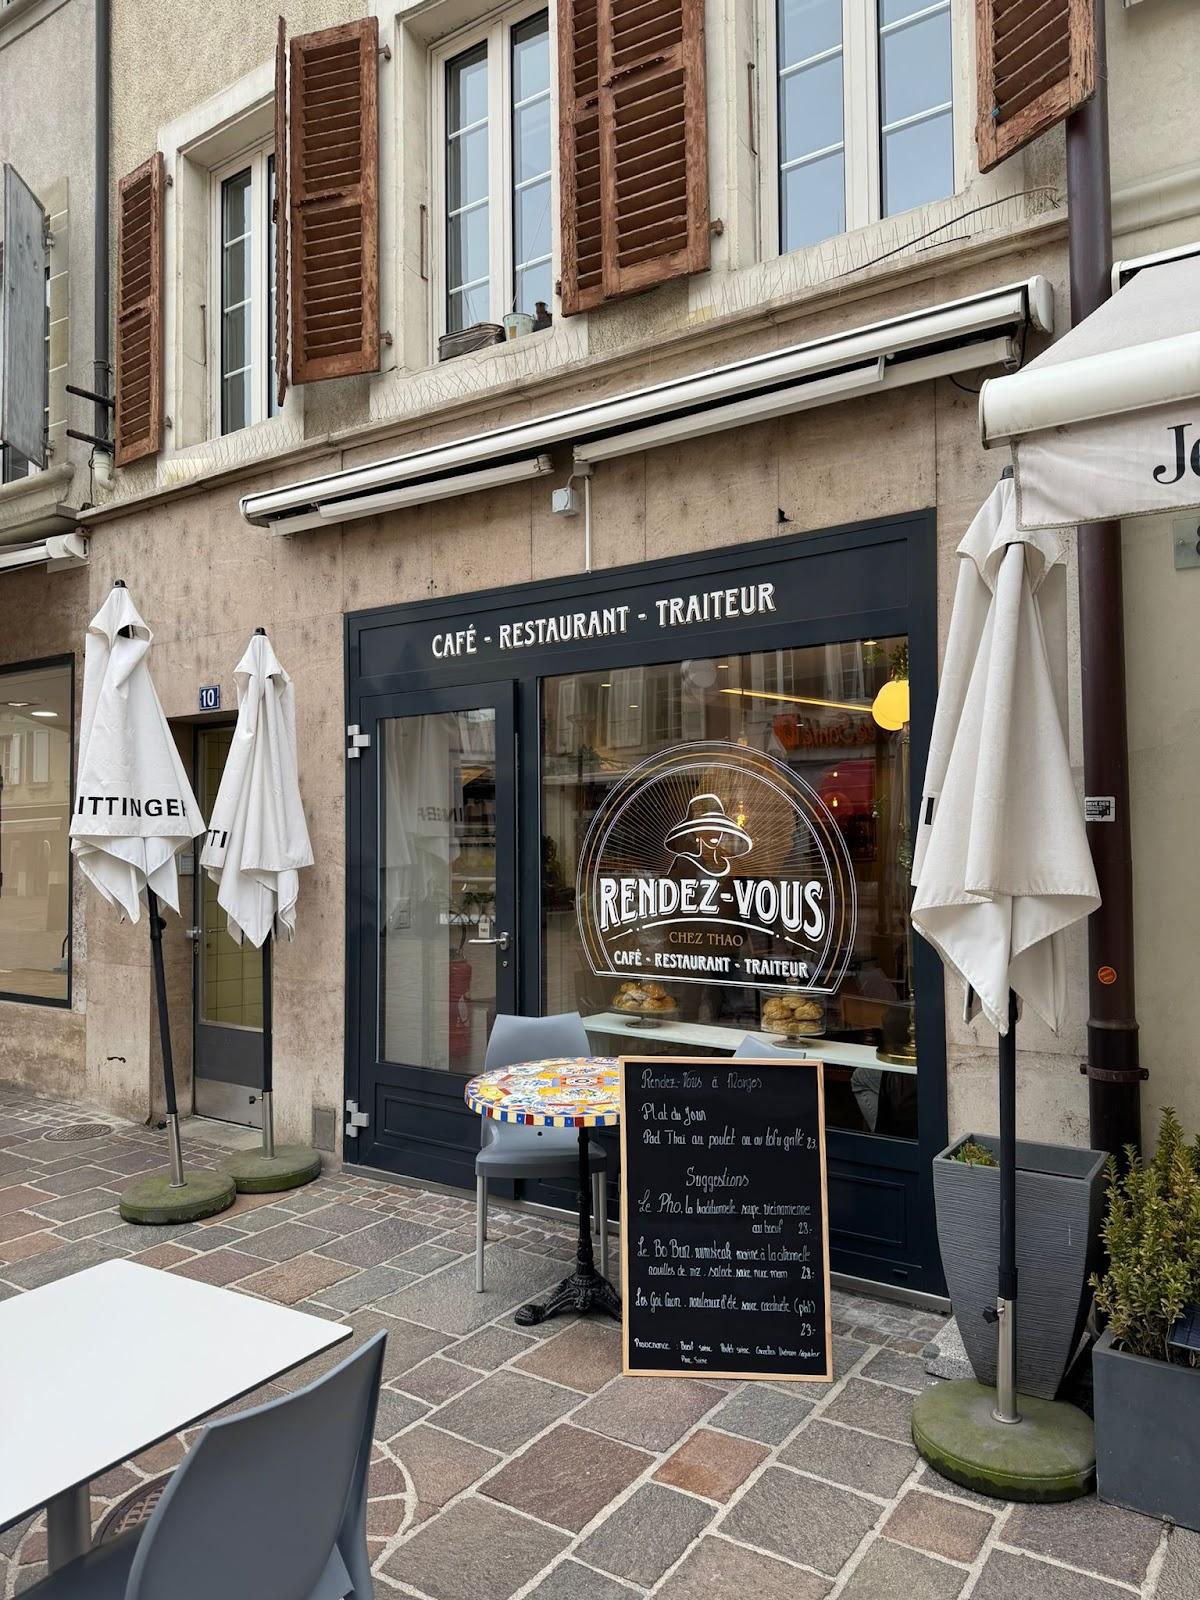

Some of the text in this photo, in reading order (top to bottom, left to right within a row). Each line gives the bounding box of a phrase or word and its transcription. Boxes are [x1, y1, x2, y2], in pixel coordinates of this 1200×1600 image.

[432, 624, 477, 658] CAFÉ
[499, 606, 630, 650] RESTAURANT
[656, 582, 776, 627] TRAITEUR
[202, 689, 215, 707] 10
[207, 829, 228, 848] TI
[600, 877, 826, 942] RENDEZ-VOUS
[669, 931, 744, 947] CHEZ THAO
[614, 948, 643, 966] CAFÉ
[654, 953, 731, 973] RESTAURANT
[744, 958, 810, 978] TRAITEUR
[728, 1071, 762, 1093] Morges
[641, 1102, 668, 1120] Plat
[670, 1106, 682, 1120] du
[643, 1128, 661, 1144] Pad
[692, 1134, 704, 1145] au
[708, 1125, 736, 1149] poulet
[741, 1135, 752, 1145] ou
[765, 1126, 782, 1147] tofu
[686, 1166, 750, 1193] Suggestions
[638, 1189, 652, 1213] Le
[685, 1194, 693, 1214] la
[752, 1223, 762, 1233] au
[637, 1235, 650, 1257] Le
[653, 1238, 668, 1258] Bo
[635, 1287, 648, 1307] Les
